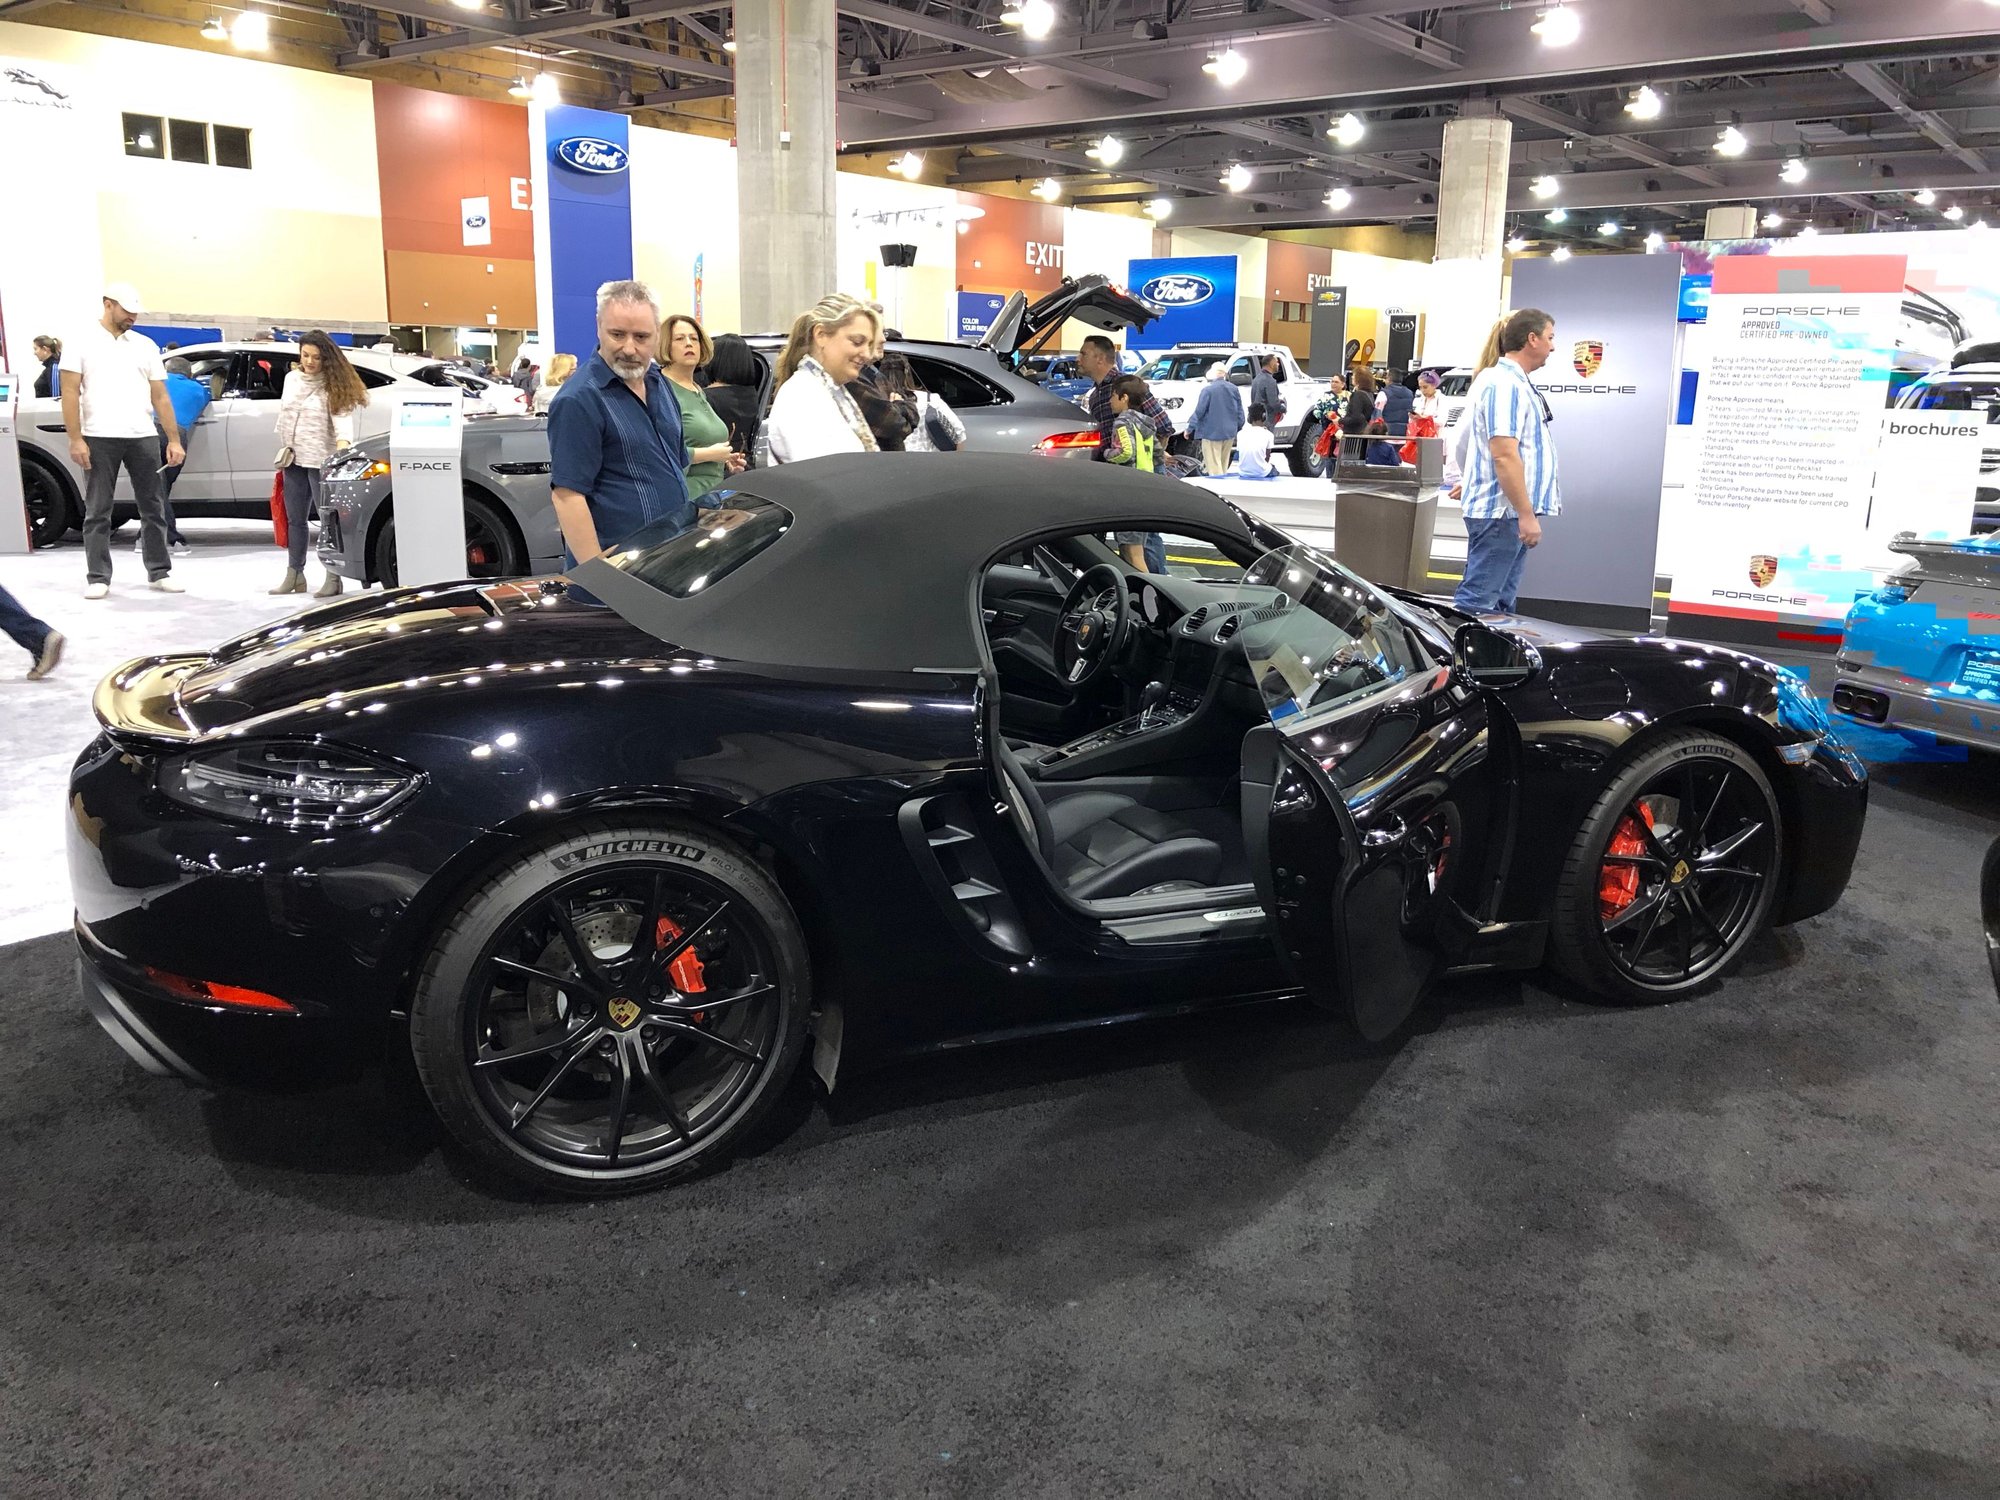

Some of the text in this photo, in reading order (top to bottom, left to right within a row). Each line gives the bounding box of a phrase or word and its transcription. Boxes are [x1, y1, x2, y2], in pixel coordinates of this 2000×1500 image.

[574, 140, 621, 169] Ford
[1025, 241, 1064, 268] EXIT
[1153, 277, 1199, 301] Ford
[1743, 306, 1860, 315] PORSCHE
[1395, 321, 1411, 329] KIA
[1741, 321, 1780, 329] APPROVED
[1740, 330, 1777, 339] CERTIFIED
[1534, 385, 1636, 394] PORSCHE
[1889, 422, 1979, 437] brochures
[400, 463, 452, 471] F-PACE
[1754, 471, 1787, 479] performed
[1700, 483, 1712, 491] Only
[1697, 499, 1721, 507] Porsche
[1727, 493, 1752, 501] Porsche
[1833, 500, 1849, 508] CPO
[1712, 589, 1807, 606] PORSCHE
[1964, 670, 1992, 679] APPROVED
[585, 840, 699, 860] MICHELIN
[710, 856, 738, 874] PILOT
